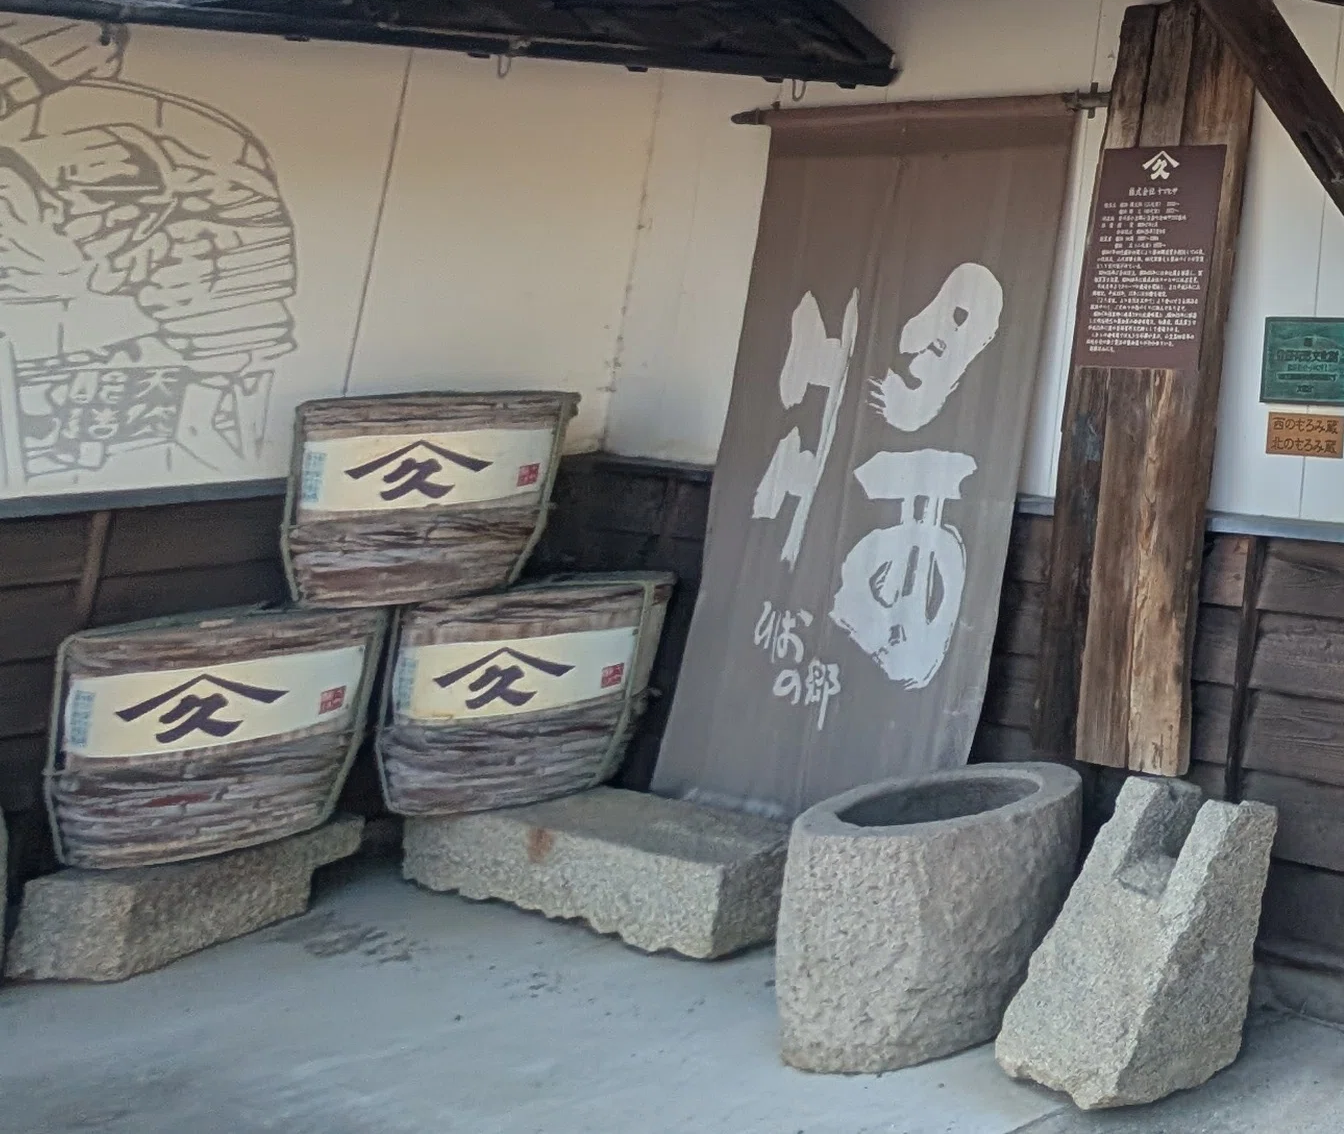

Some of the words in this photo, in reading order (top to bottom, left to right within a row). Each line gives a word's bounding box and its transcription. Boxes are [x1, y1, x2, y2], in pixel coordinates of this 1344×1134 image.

[1272, 416, 1339, 435] 西のもろみ蔵
[1270, 437, 1337, 454] 北のもろみ蔵
